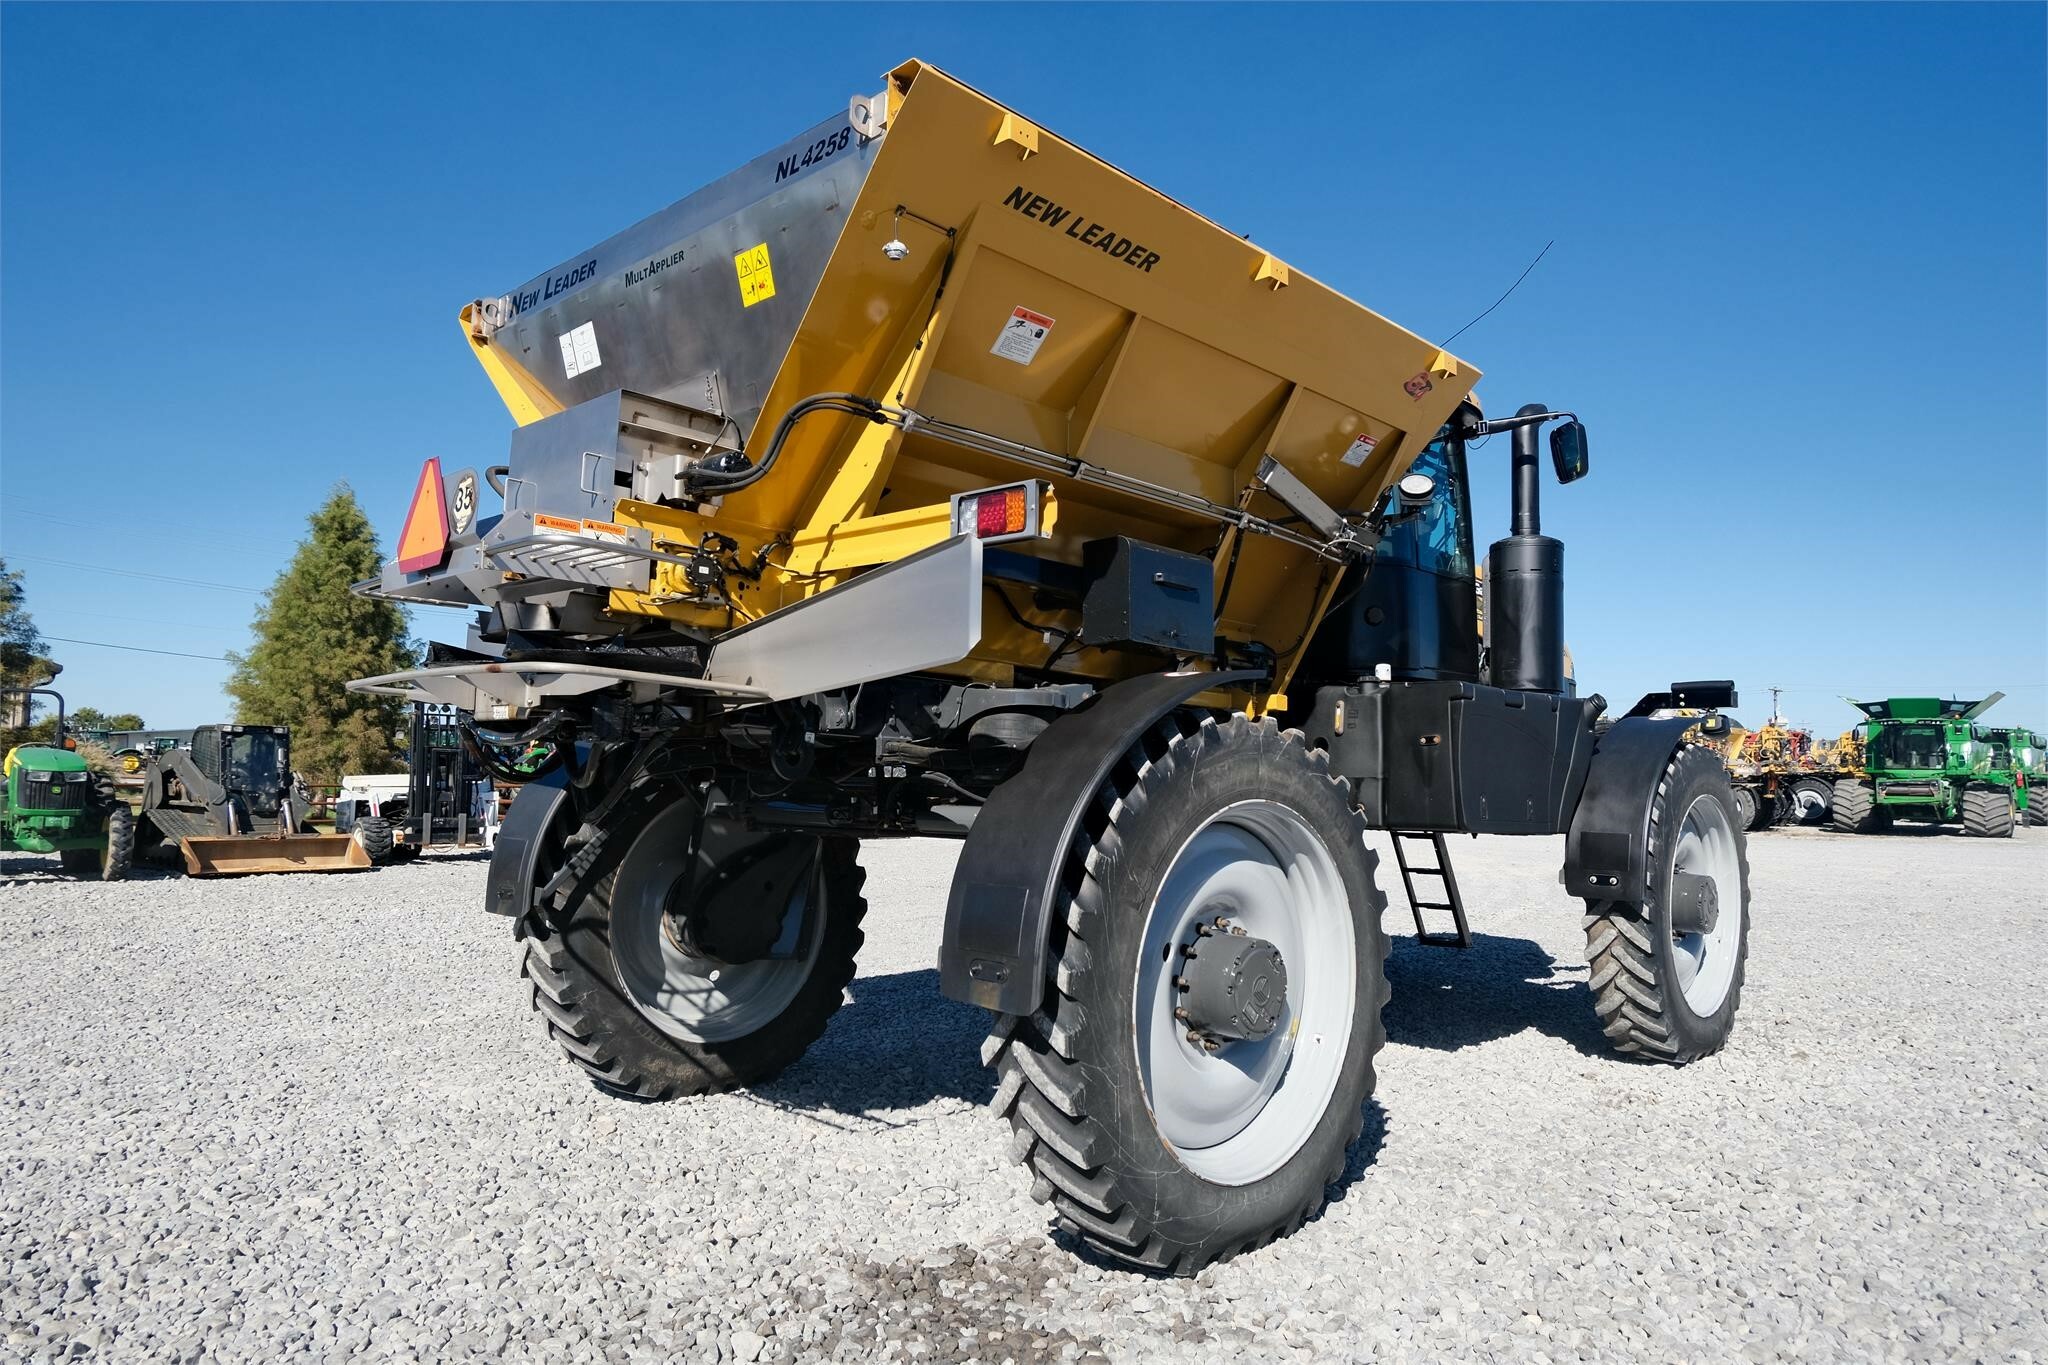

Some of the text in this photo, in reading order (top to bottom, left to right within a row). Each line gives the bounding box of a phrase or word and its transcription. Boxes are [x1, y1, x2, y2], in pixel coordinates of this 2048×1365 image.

[775, 126, 851, 184] NL4258
[1002, 185, 1161, 273] NEW LEADER
[508, 259, 597, 318] NEW LEADER
[455, 486, 473, 512] 35
[550, 520, 577, 530] WARNING
[596, 524, 622, 534] WARNING
